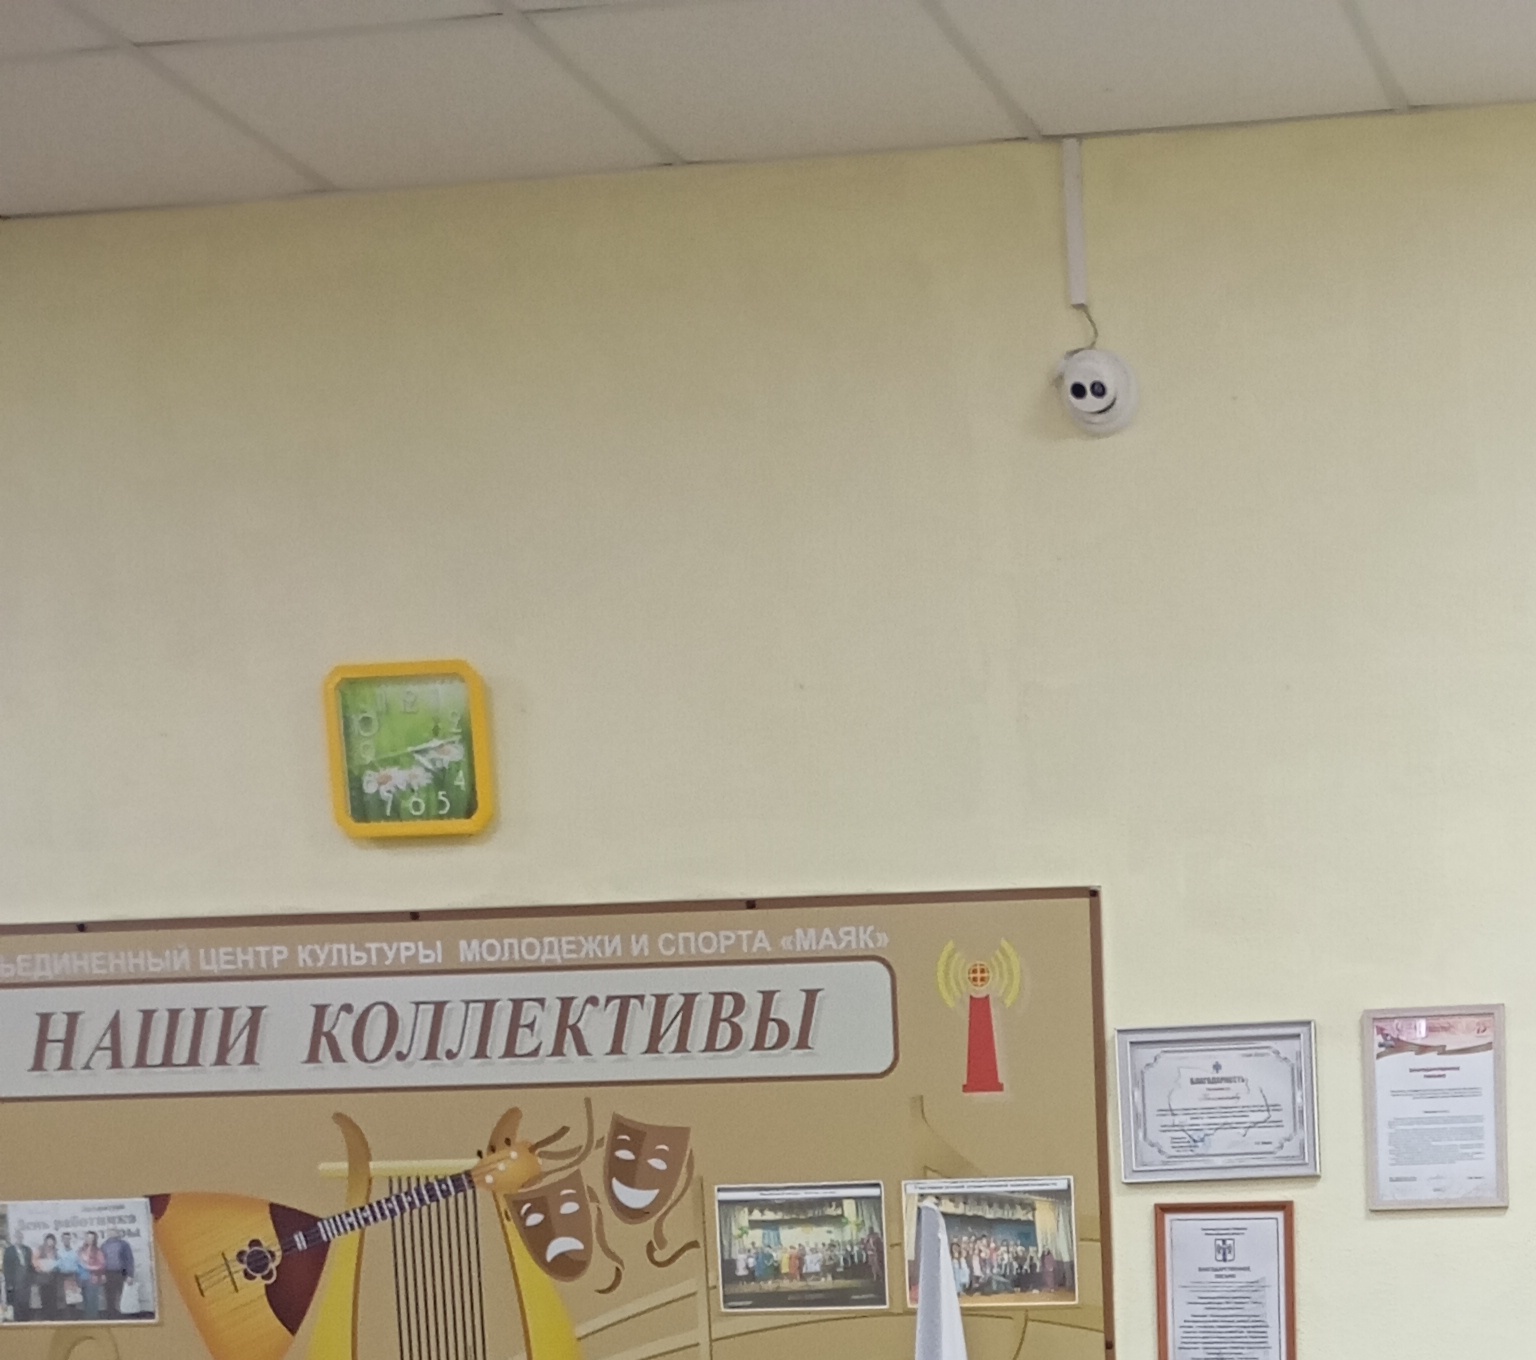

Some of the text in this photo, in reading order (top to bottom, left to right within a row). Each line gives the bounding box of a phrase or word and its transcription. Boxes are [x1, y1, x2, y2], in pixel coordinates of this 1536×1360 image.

[453, 770, 466, 791] 4
[437, 791, 451, 814] 5
[199, 945, 289, 972] ЦЕНТР
[298, 941, 442, 968] КУЛЬТУРЫ
[459, 932, 622, 964] МОЛОДЕЖИ
[631, 933, 650, 956] И
[659, 930, 771, 956] СПОРТА
[780, 925, 889, 952] «МАЯК»
[28, 988, 825, 1072] НАШИ КОЛЛЕКТИВЫ
